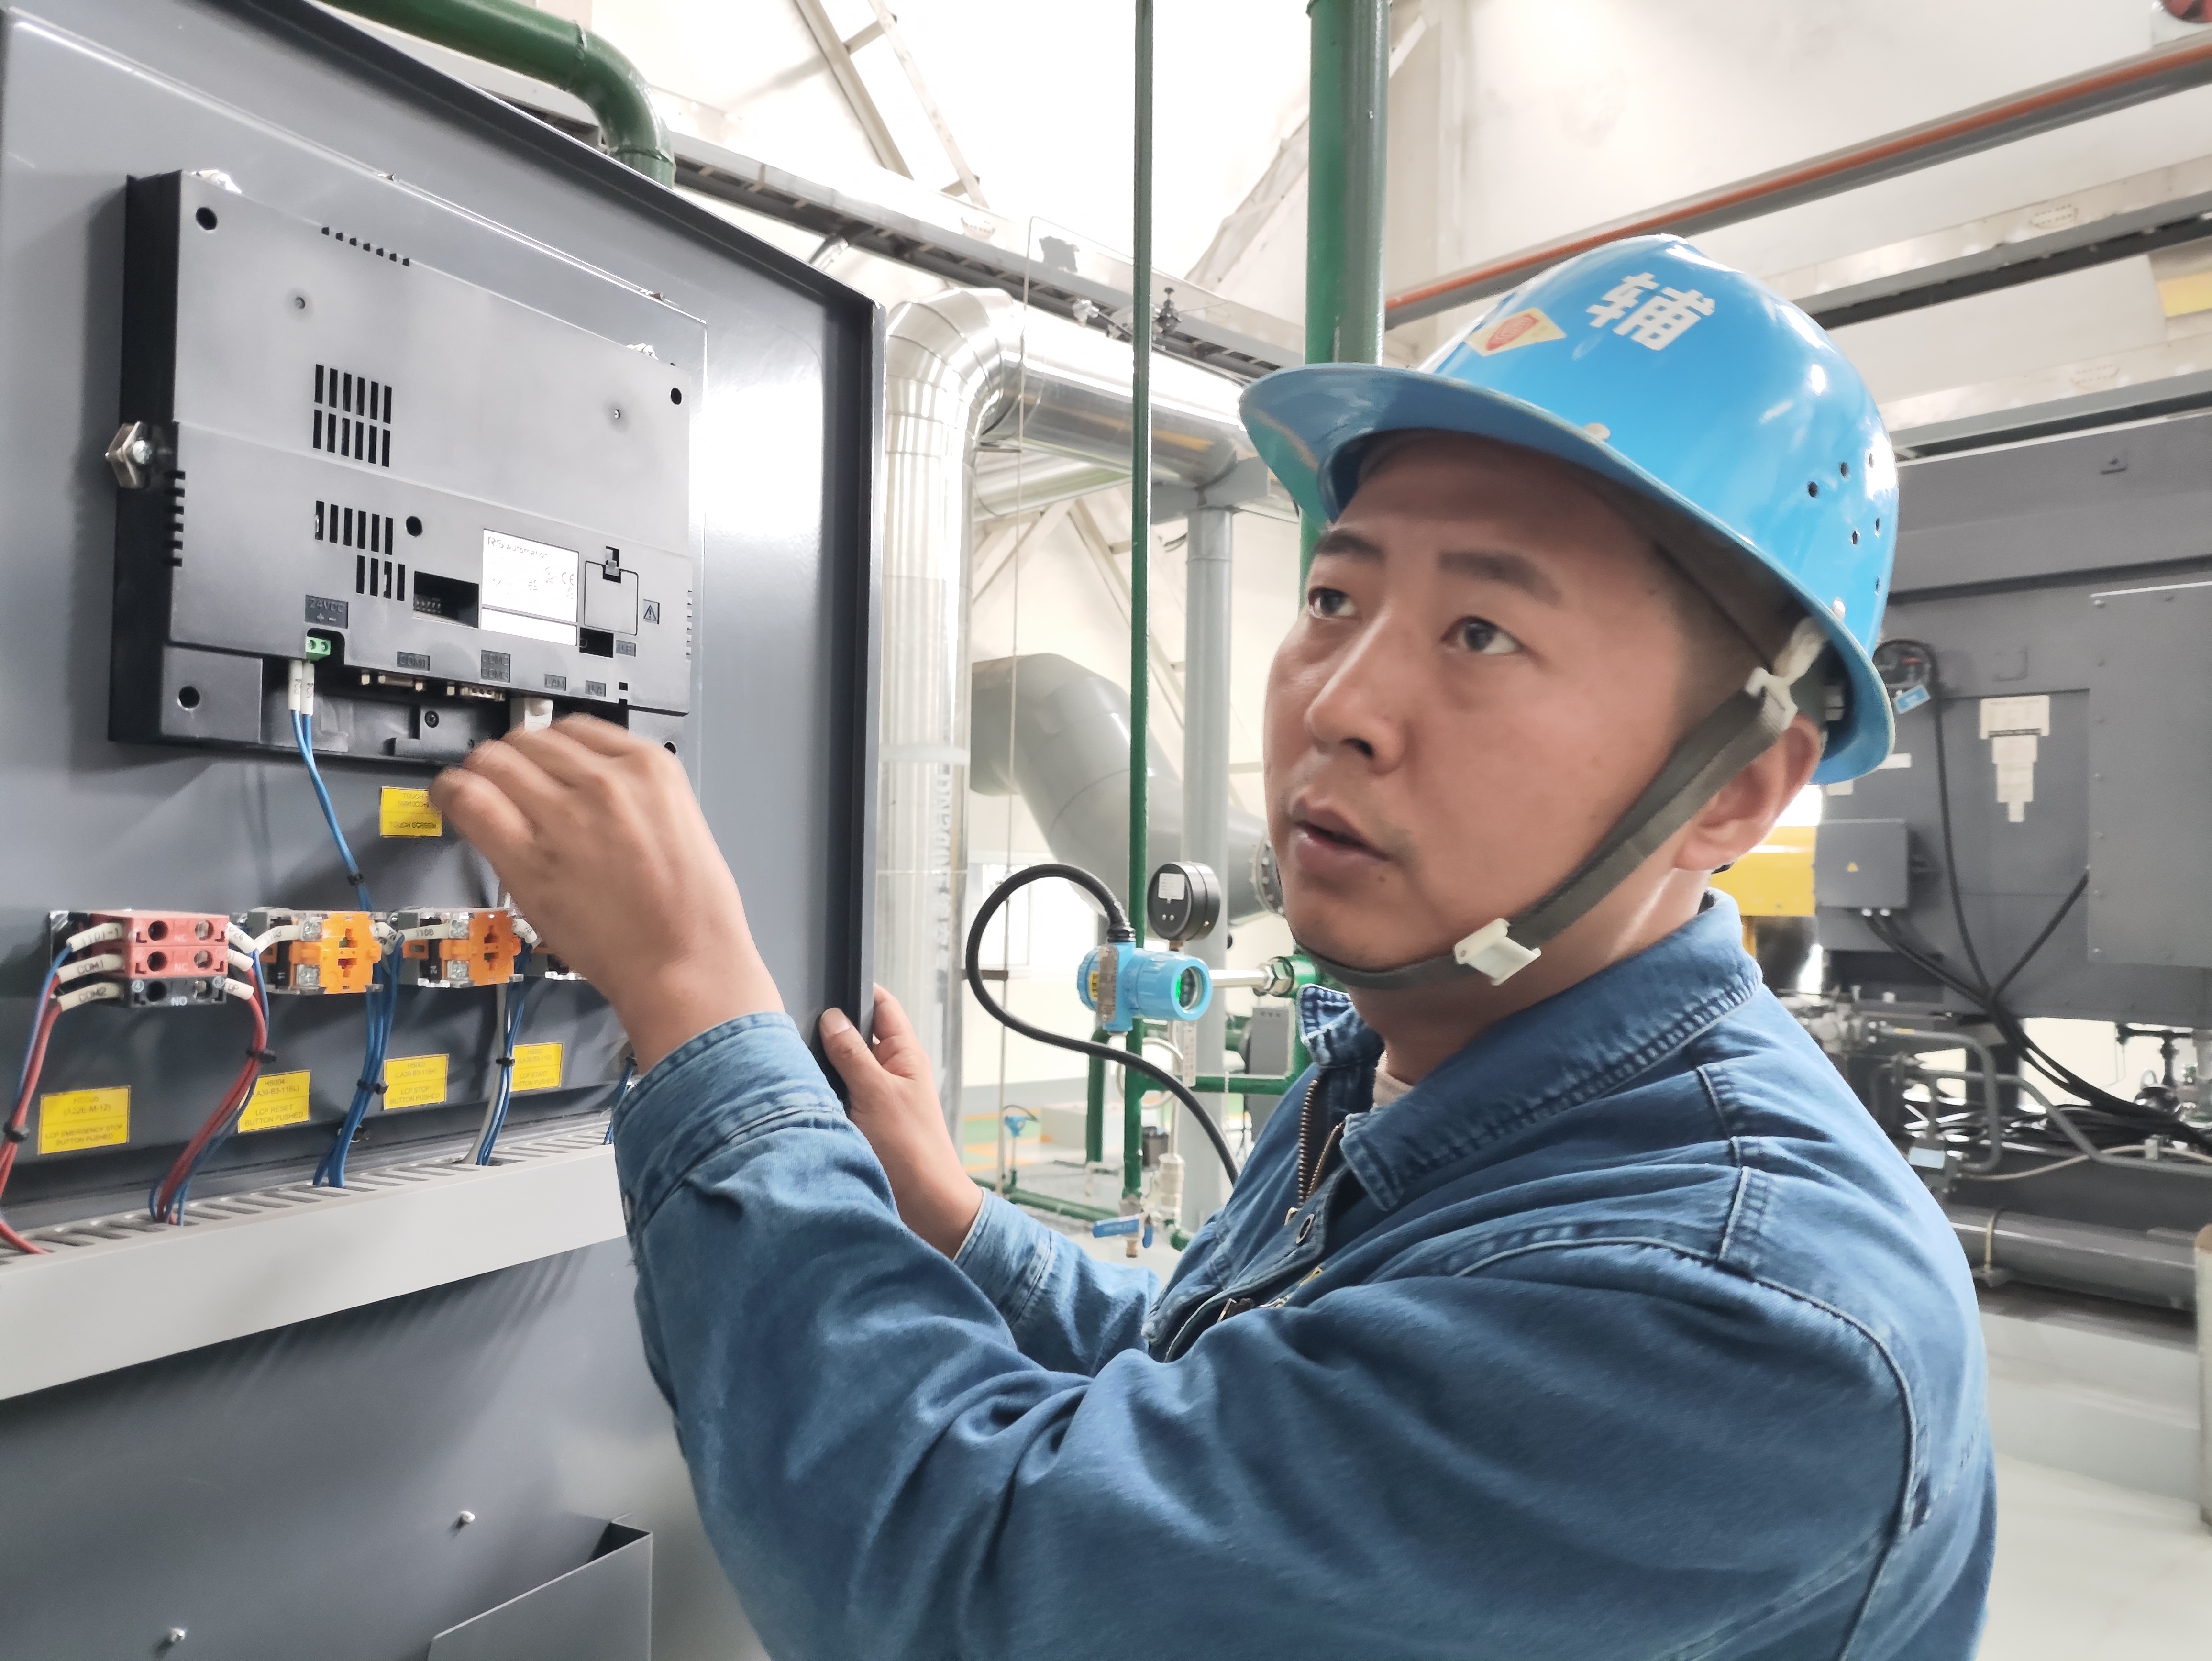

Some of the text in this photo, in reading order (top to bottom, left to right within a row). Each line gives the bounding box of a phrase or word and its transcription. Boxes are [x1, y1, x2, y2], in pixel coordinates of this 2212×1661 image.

[1586, 272, 1715, 351] 辅
[487, 537, 504, 548] RS
[310, 598, 344, 612] 24VDC
[398, 654, 425, 668] COM1
[545, 677, 564, 688] LAN
[174, 934, 187, 943] NC
[174, 963, 188, 972] NC
[171, 996, 187, 1006] NO
[264, 1078, 285, 1087] HS004
[512, 1077, 555, 1088] BUTTON PUSHED
[390, 1093, 440, 1105] BUTTON PUSHED
[270, 1104, 293, 1114] RESET
[245, 1111, 303, 1126] BUTTON PUSHED
[45, 1123, 123, 1139] LCP EMERGENCY STOP
[56, 1133, 113, 1146] BUTTON PUSHED
